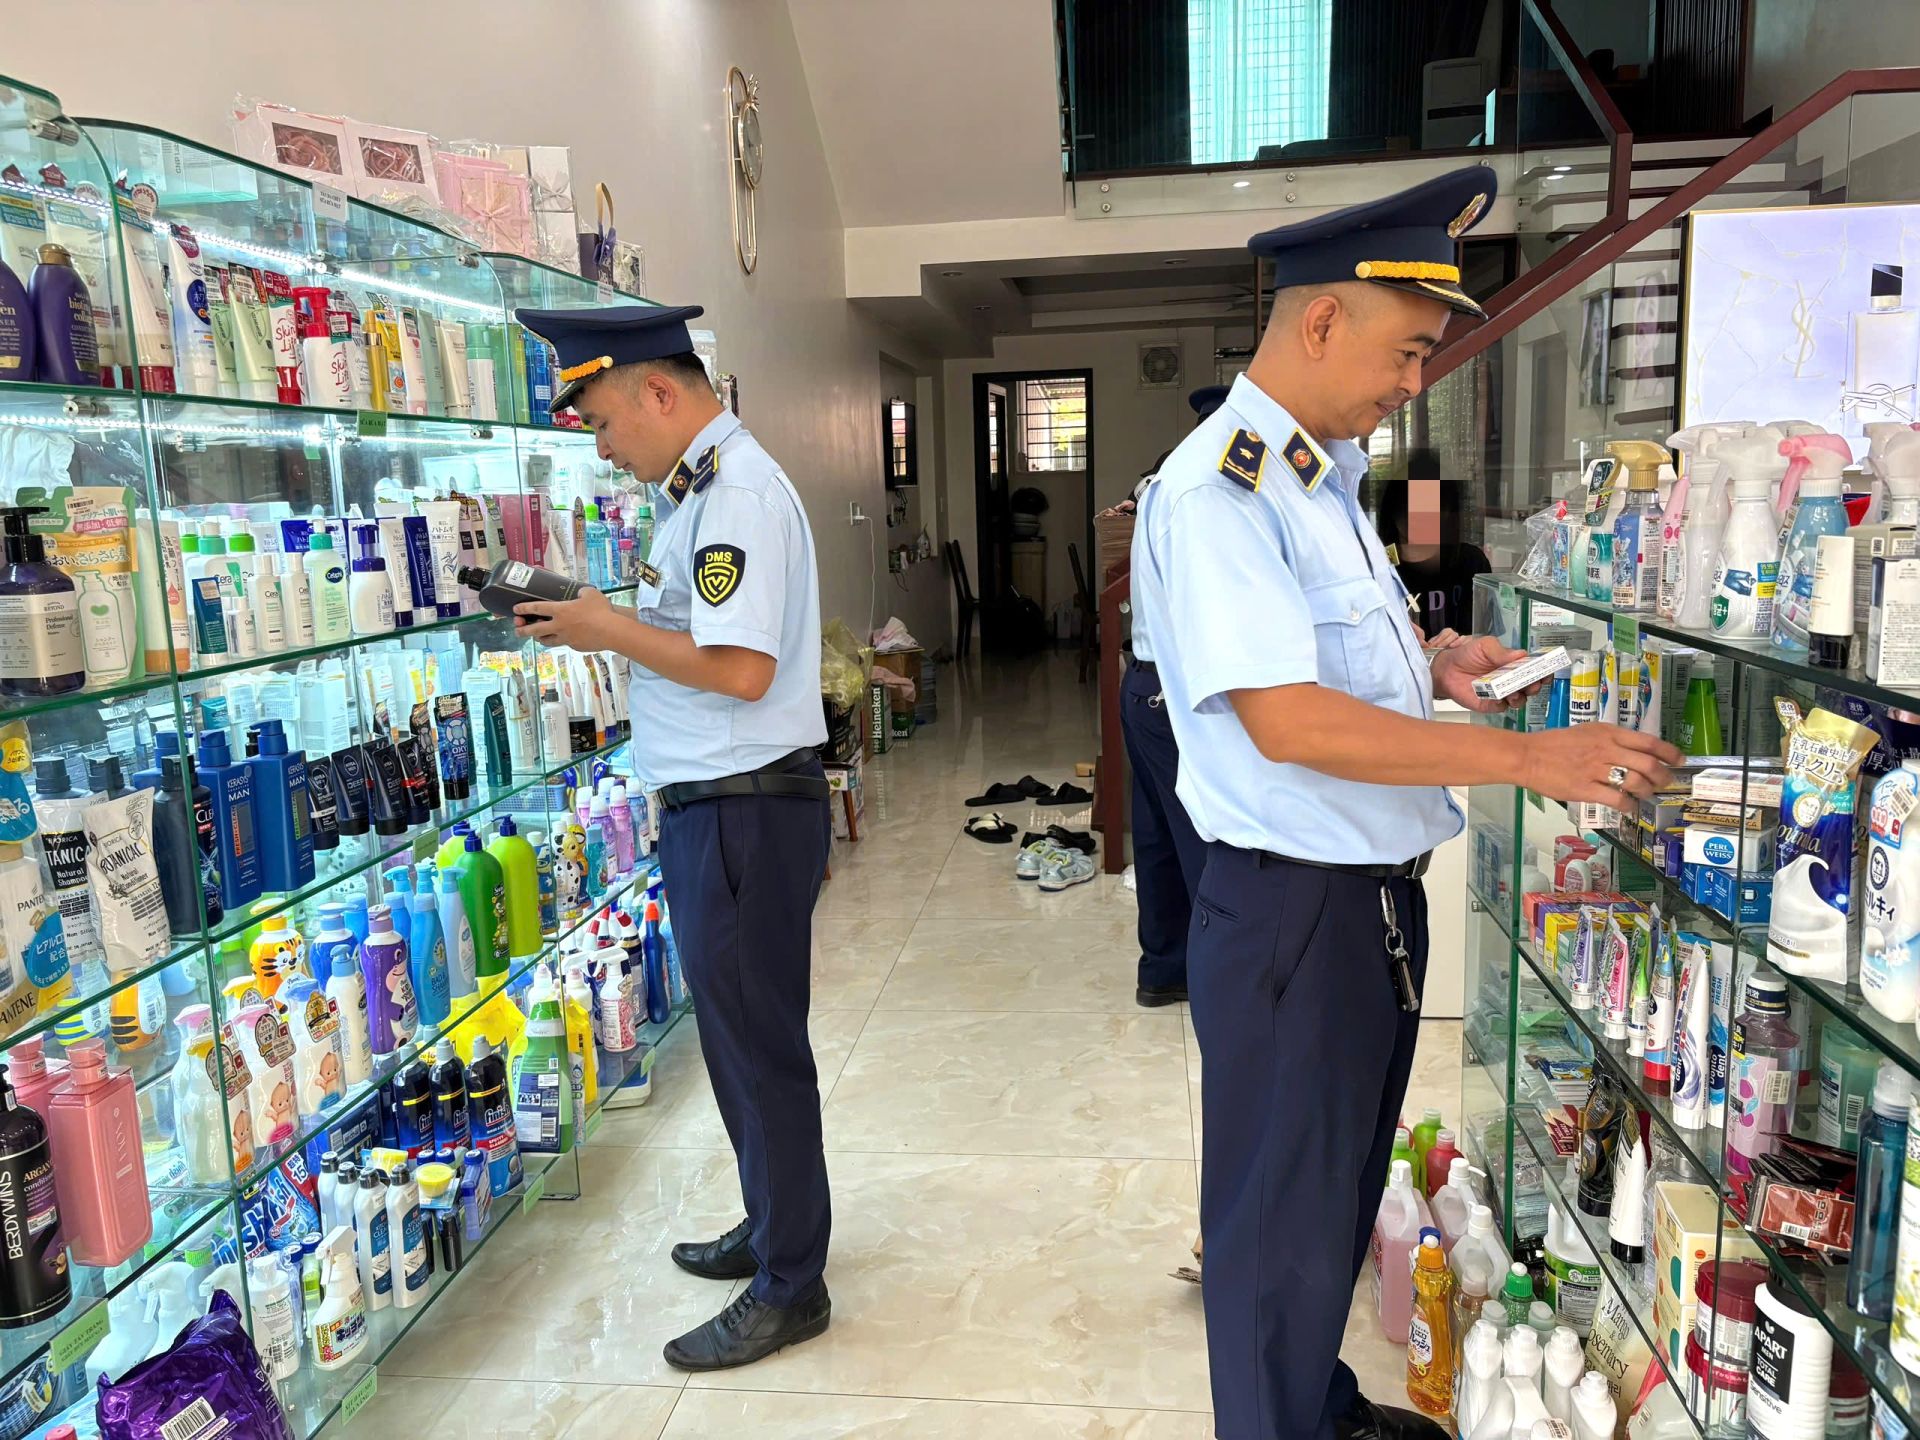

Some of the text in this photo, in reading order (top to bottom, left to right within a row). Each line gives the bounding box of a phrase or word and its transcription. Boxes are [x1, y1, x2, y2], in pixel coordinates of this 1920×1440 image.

[705, 551, 733, 563] DMS
[1571, 688, 1594, 699] Thera
[1571, 699, 1591, 710] med
[871, 686, 882, 739] Heineken
[452, 745, 468, 754] OXY
[289, 775, 305, 788] MAN
[228, 788, 250, 802] MAN
[1708, 842, 1728, 850] PERL
[1705, 850, 1732, 860] WEISS
[56, 867, 85, 879] Natural
[1717, 1053, 1726, 1079] dent
[1602, 1296, 1630, 1341] Mango
[1754, 1325, 1788, 1360] APART
[1761, 1346, 1774, 1361] MEN
[1756, 1356, 1777, 1379] TOTAL
[1756, 1365, 1776, 1388] CARE
